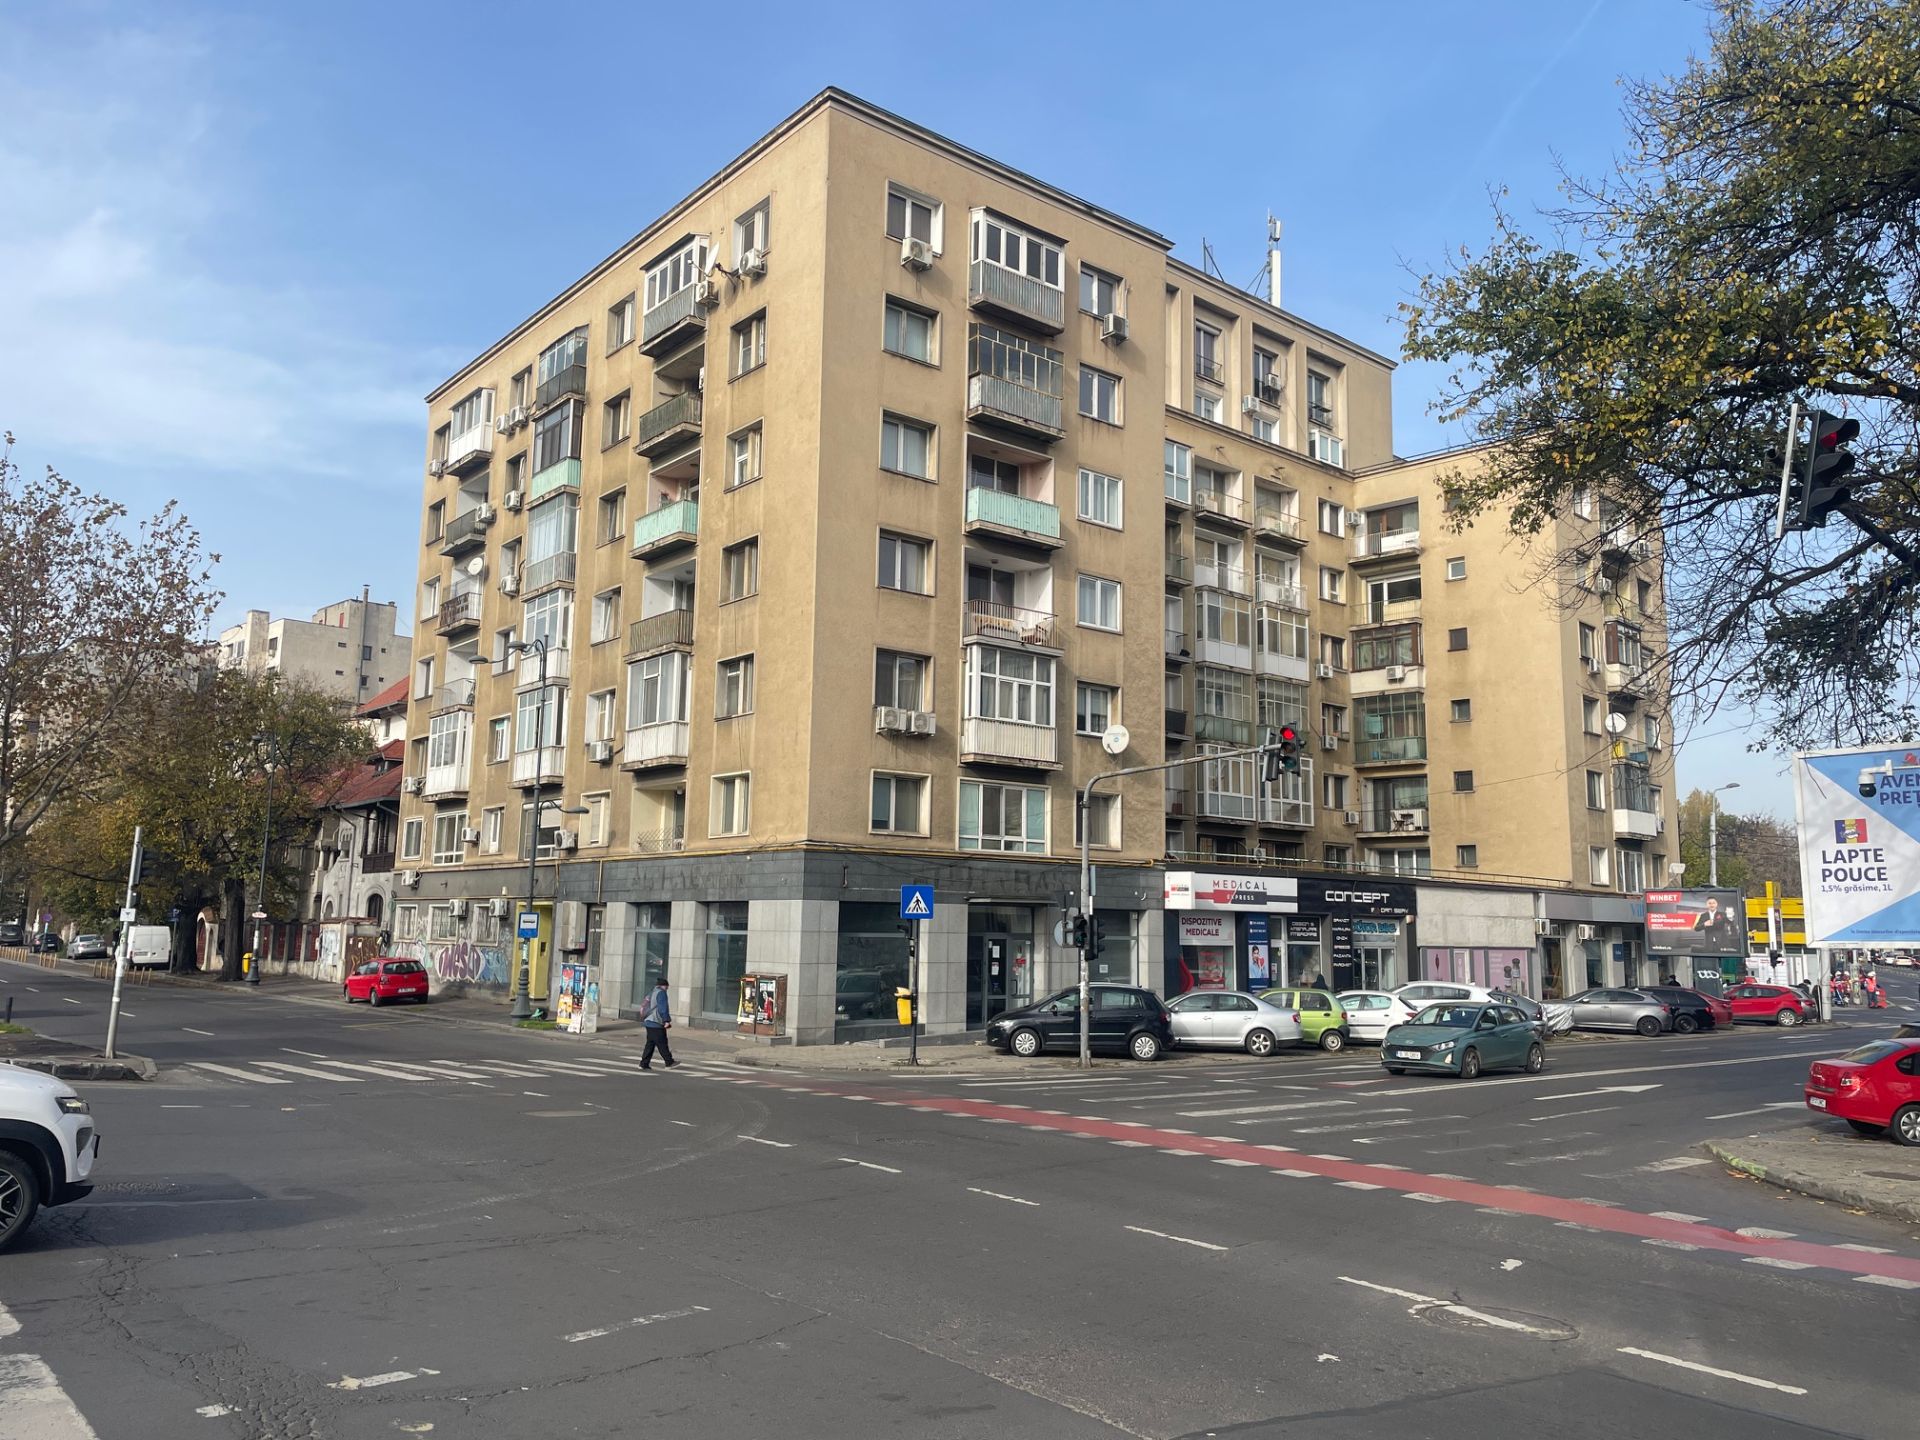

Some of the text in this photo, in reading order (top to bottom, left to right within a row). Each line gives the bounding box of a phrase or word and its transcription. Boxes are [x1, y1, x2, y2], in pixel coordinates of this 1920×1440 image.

[1822, 848, 1885, 864] LAPTE
[1822, 867, 1888, 882] POUCE
[1213, 880, 1267, 890] MEDICAL
[1821, 885, 1842, 893] 1,5%
[1325, 890, 1390, 903] CONCEPT
[1181, 918, 1222, 926] DISPOZITIVE
